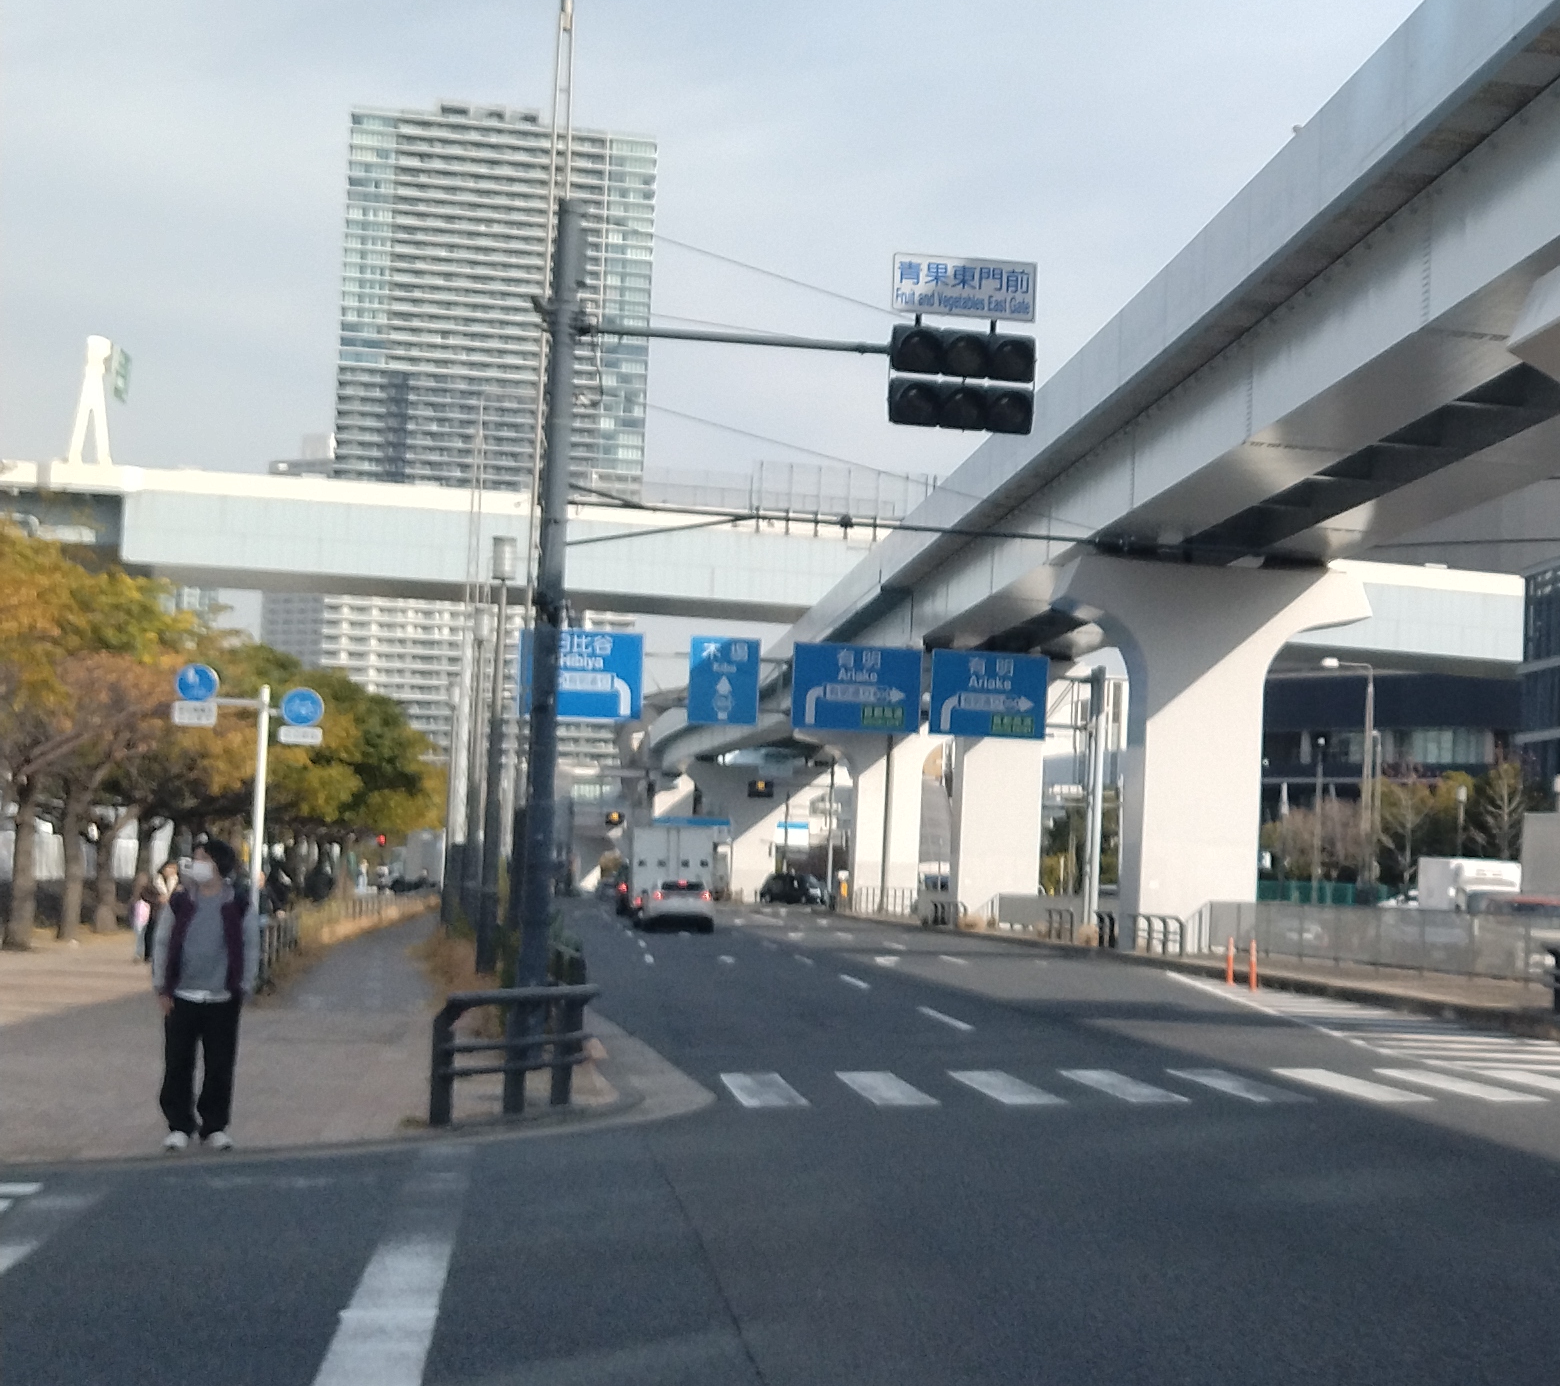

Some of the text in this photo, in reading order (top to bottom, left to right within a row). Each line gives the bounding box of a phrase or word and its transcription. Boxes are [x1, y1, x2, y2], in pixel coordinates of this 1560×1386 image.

[899, 259, 1030, 294] 青果東門前
[896, 287, 1030, 315] Fruit and Vegetables East Gate
